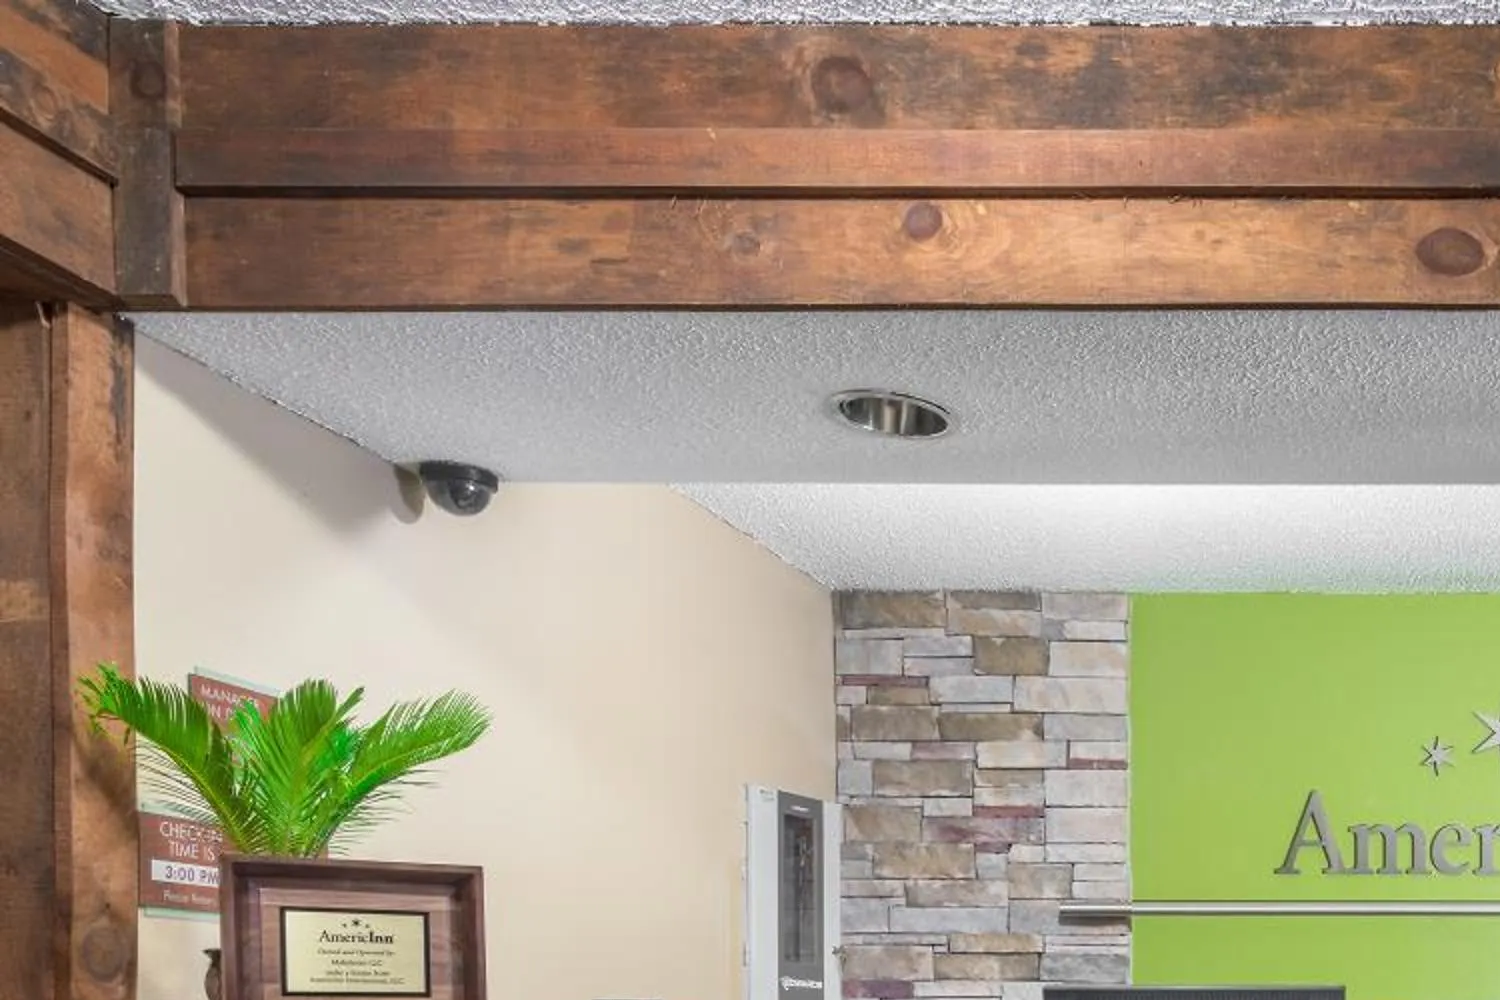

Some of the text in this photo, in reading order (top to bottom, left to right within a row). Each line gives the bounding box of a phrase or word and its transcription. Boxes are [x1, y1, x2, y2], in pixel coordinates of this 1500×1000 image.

[159, 820, 223, 844] CHEC
[167, 840, 216, 862] TIME IS
[165, 865, 195, 882] 3:00
[319, 929, 394, 945] AmericInn
